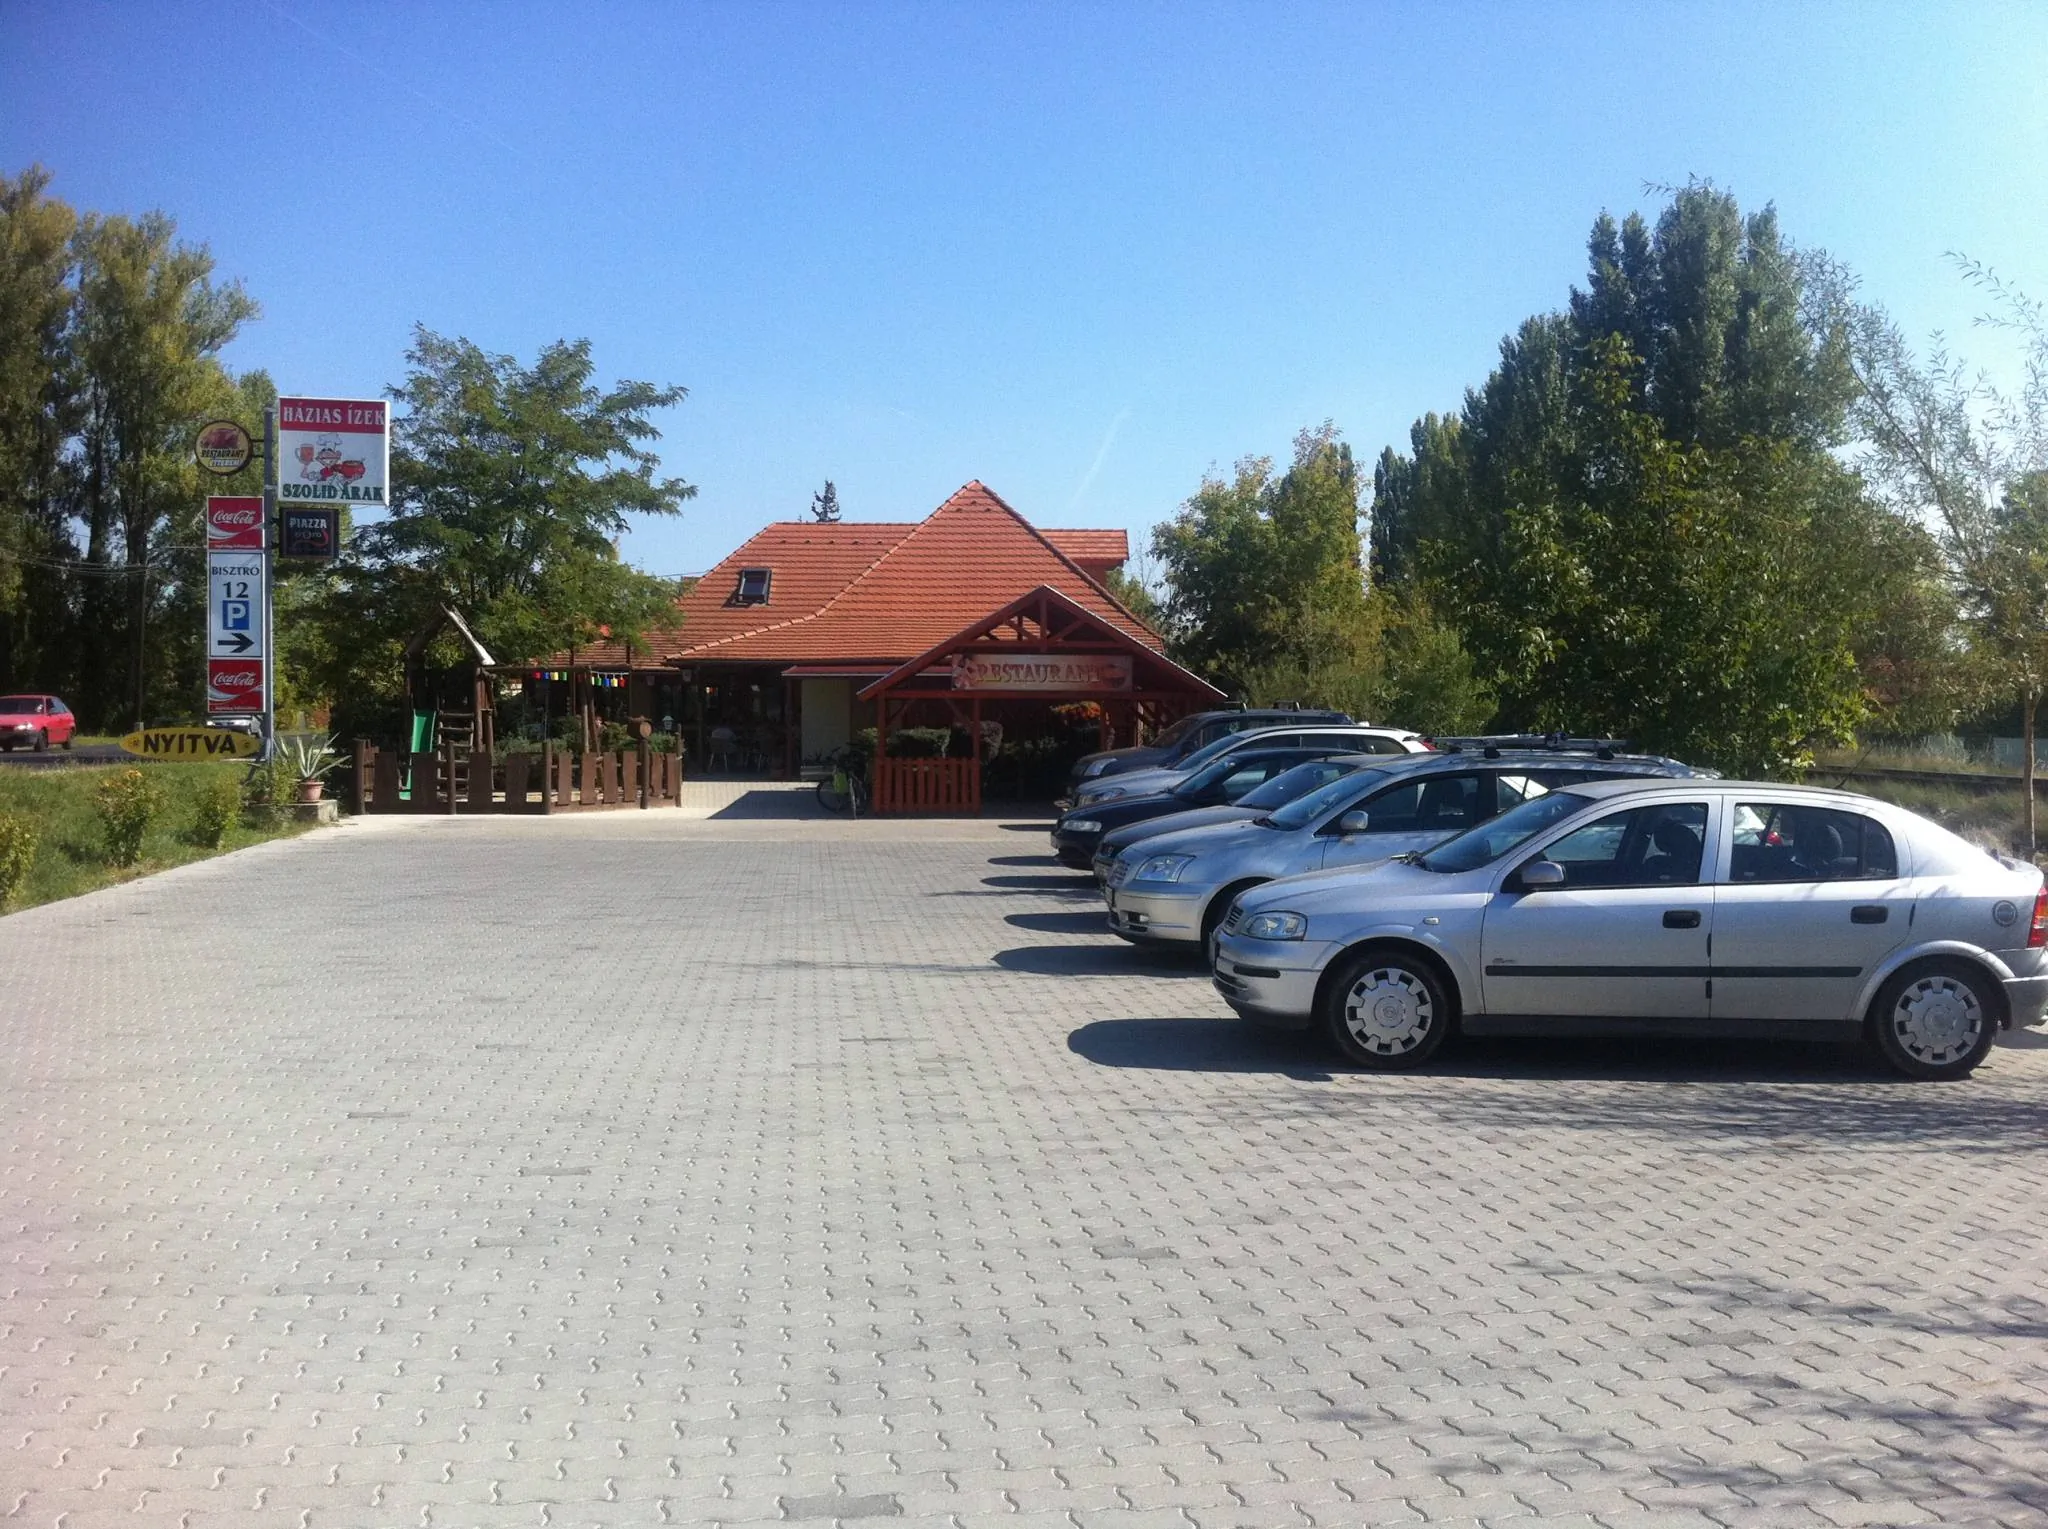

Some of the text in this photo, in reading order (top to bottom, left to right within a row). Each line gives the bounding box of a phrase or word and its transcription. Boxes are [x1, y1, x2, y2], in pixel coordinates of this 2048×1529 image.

[283, 402, 386, 425] HÁZIAS ÍZEK
[282, 481, 385, 500] SZOLID ÁRAK
[289, 516, 328, 529] PIAZZA
[212, 564, 260, 576] BISZTRÓ
[222, 581, 249, 598] 12
[227, 604, 247, 628] P
[976, 663, 1101, 683] RESTAURANT
[143, 733, 237, 755] NYITVA
